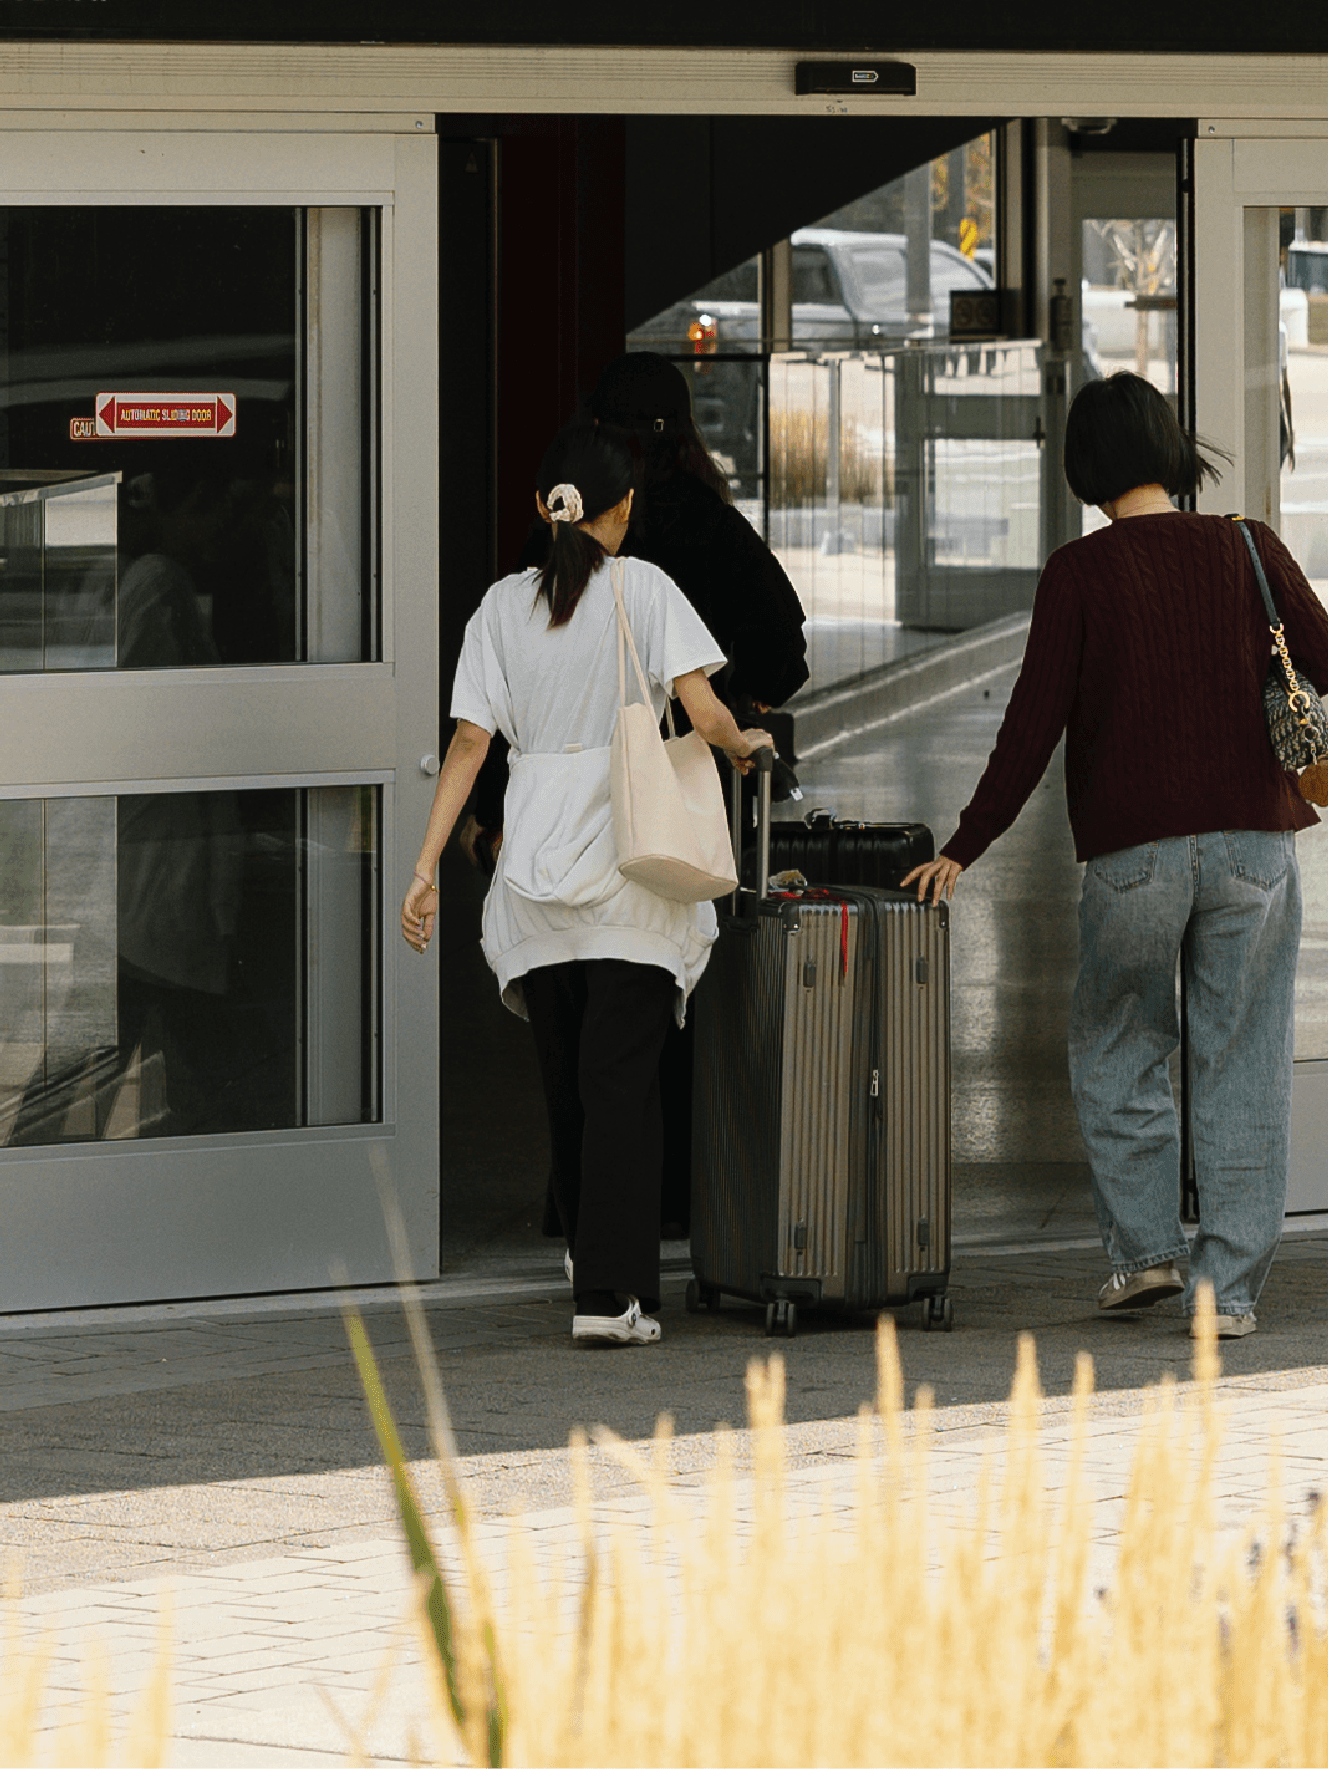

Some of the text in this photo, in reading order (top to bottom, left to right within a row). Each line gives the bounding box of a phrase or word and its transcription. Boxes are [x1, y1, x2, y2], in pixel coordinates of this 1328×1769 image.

[120, 408, 212, 421] AUTOMATIC SLIDING DOOR
